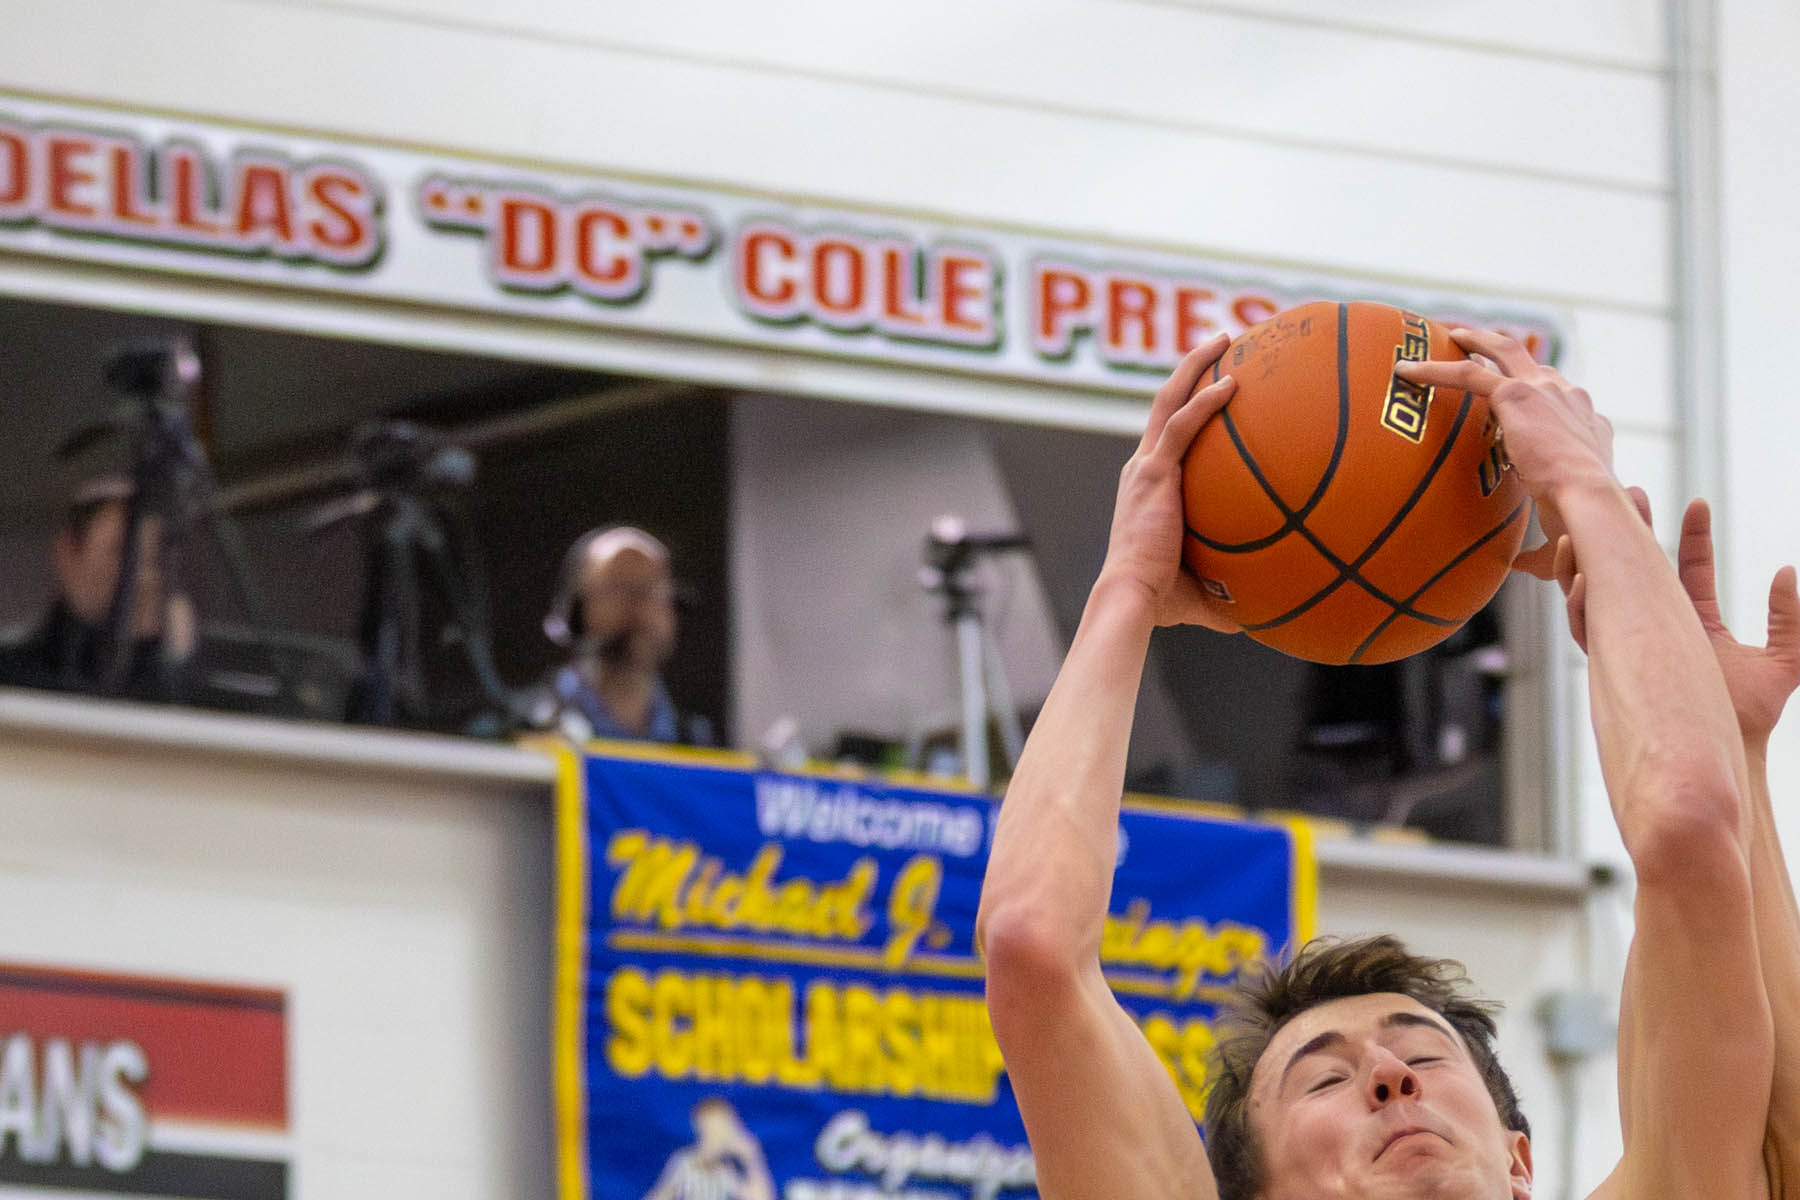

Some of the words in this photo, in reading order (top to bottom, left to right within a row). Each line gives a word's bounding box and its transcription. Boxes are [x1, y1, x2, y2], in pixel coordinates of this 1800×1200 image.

[0, 124, 376, 260] DELLAS
[737, 222, 994, 338] COLE
[754, 775, 983, 857] Welcome
[607, 830, 877, 938] Michael
